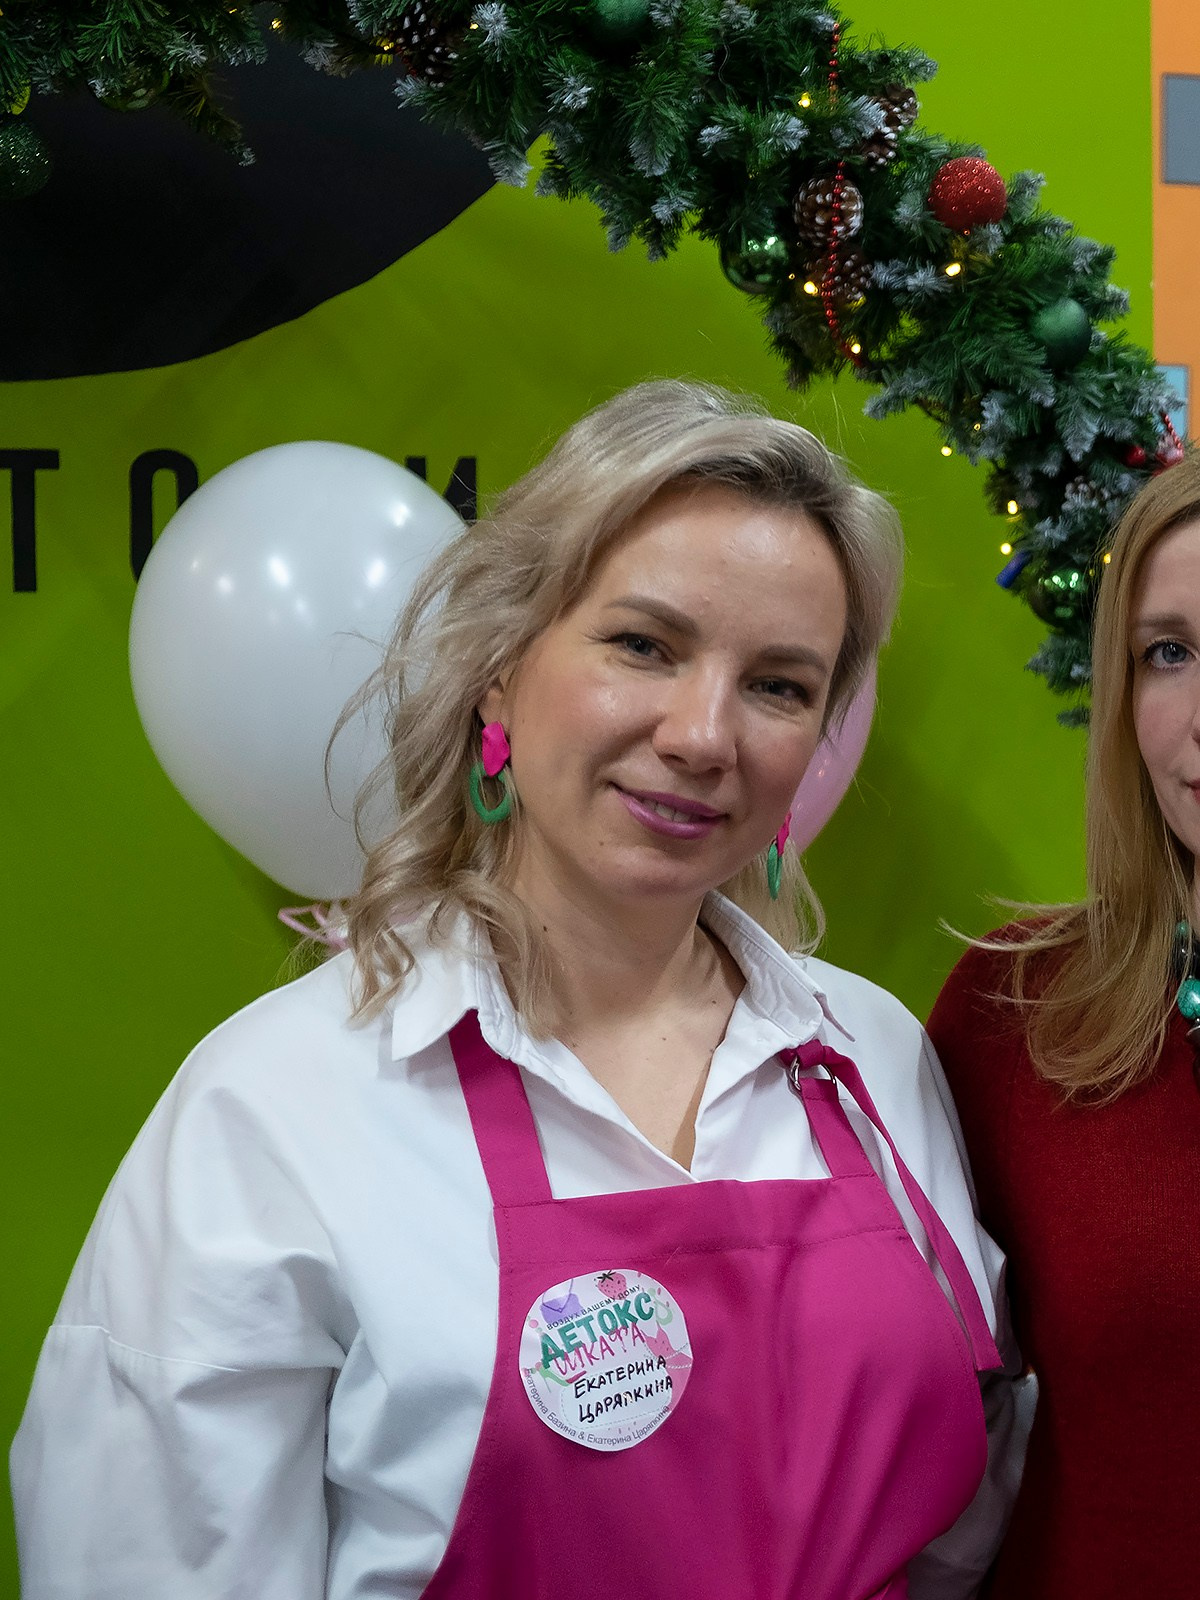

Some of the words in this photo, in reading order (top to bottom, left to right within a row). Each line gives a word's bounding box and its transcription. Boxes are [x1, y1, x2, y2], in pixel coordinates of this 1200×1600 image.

[540, 1292, 654, 1369] ДЕТОКС
[546, 1313, 580, 1330] ВОЗДУХ
[581, 1296, 616, 1316] ВАШЕМУ
[618, 1284, 641, 1301] ДОМУ
[552, 1322, 646, 1376] ШКАФА
[574, 1355, 667, 1399] ЕКАТЕРИНА
[525, 1369, 548, 1415] Екатерина
[547, 1411, 576, 1437] Базина
[578, 1431, 585, 1440] &
[587, 1433, 632, 1447] Екатерина
